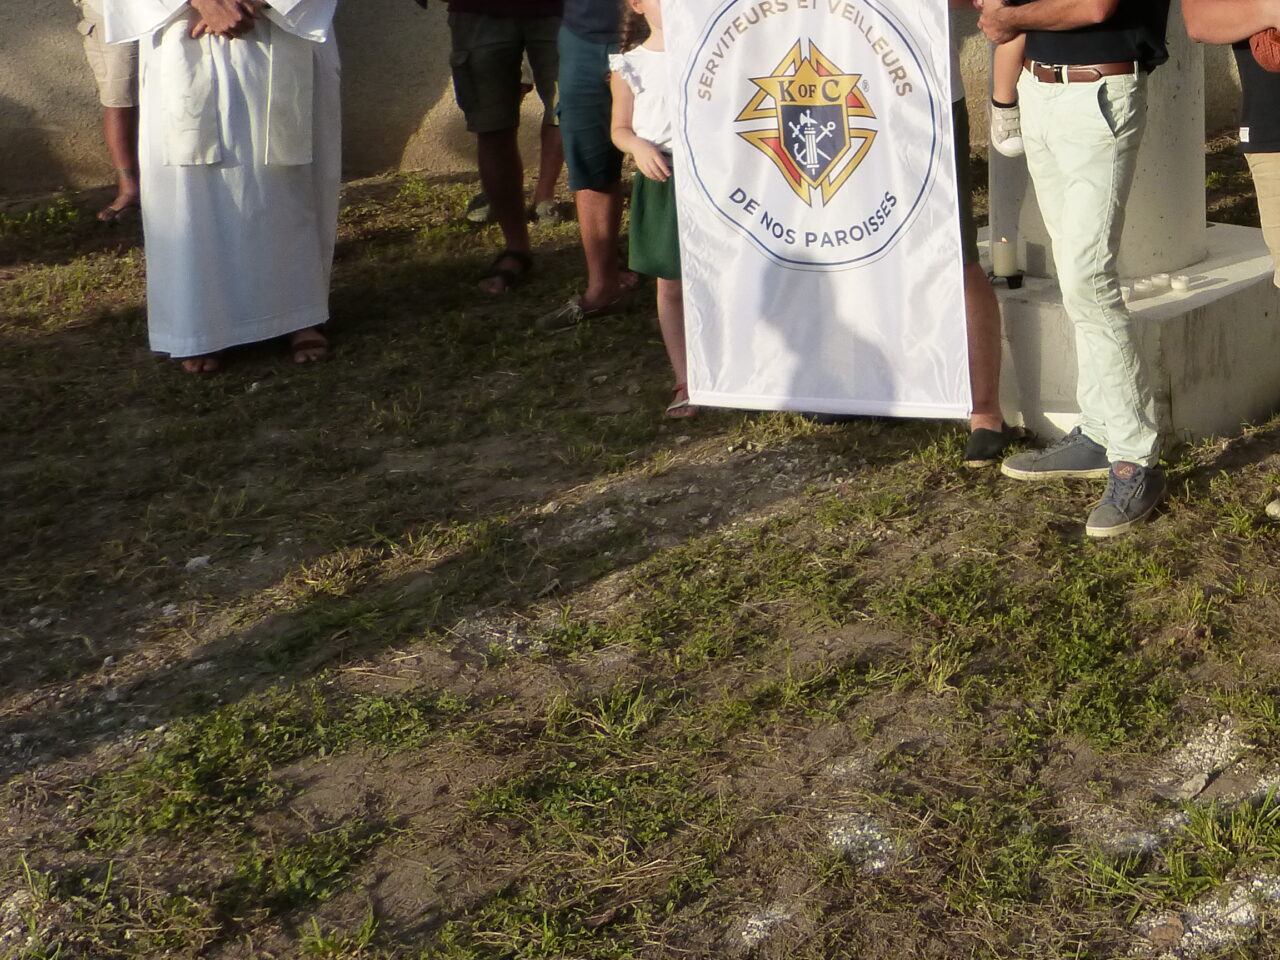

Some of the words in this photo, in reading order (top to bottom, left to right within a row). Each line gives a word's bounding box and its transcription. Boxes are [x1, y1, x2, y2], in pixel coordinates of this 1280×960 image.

[777, 80, 797, 102] K
[798, 84, 817, 98] OF
[822, 79, 842, 102] C
[728, 187, 760, 216] DE
[760, 211, 796, 245] NOS
[805, 191, 898, 248] PAROISSES
